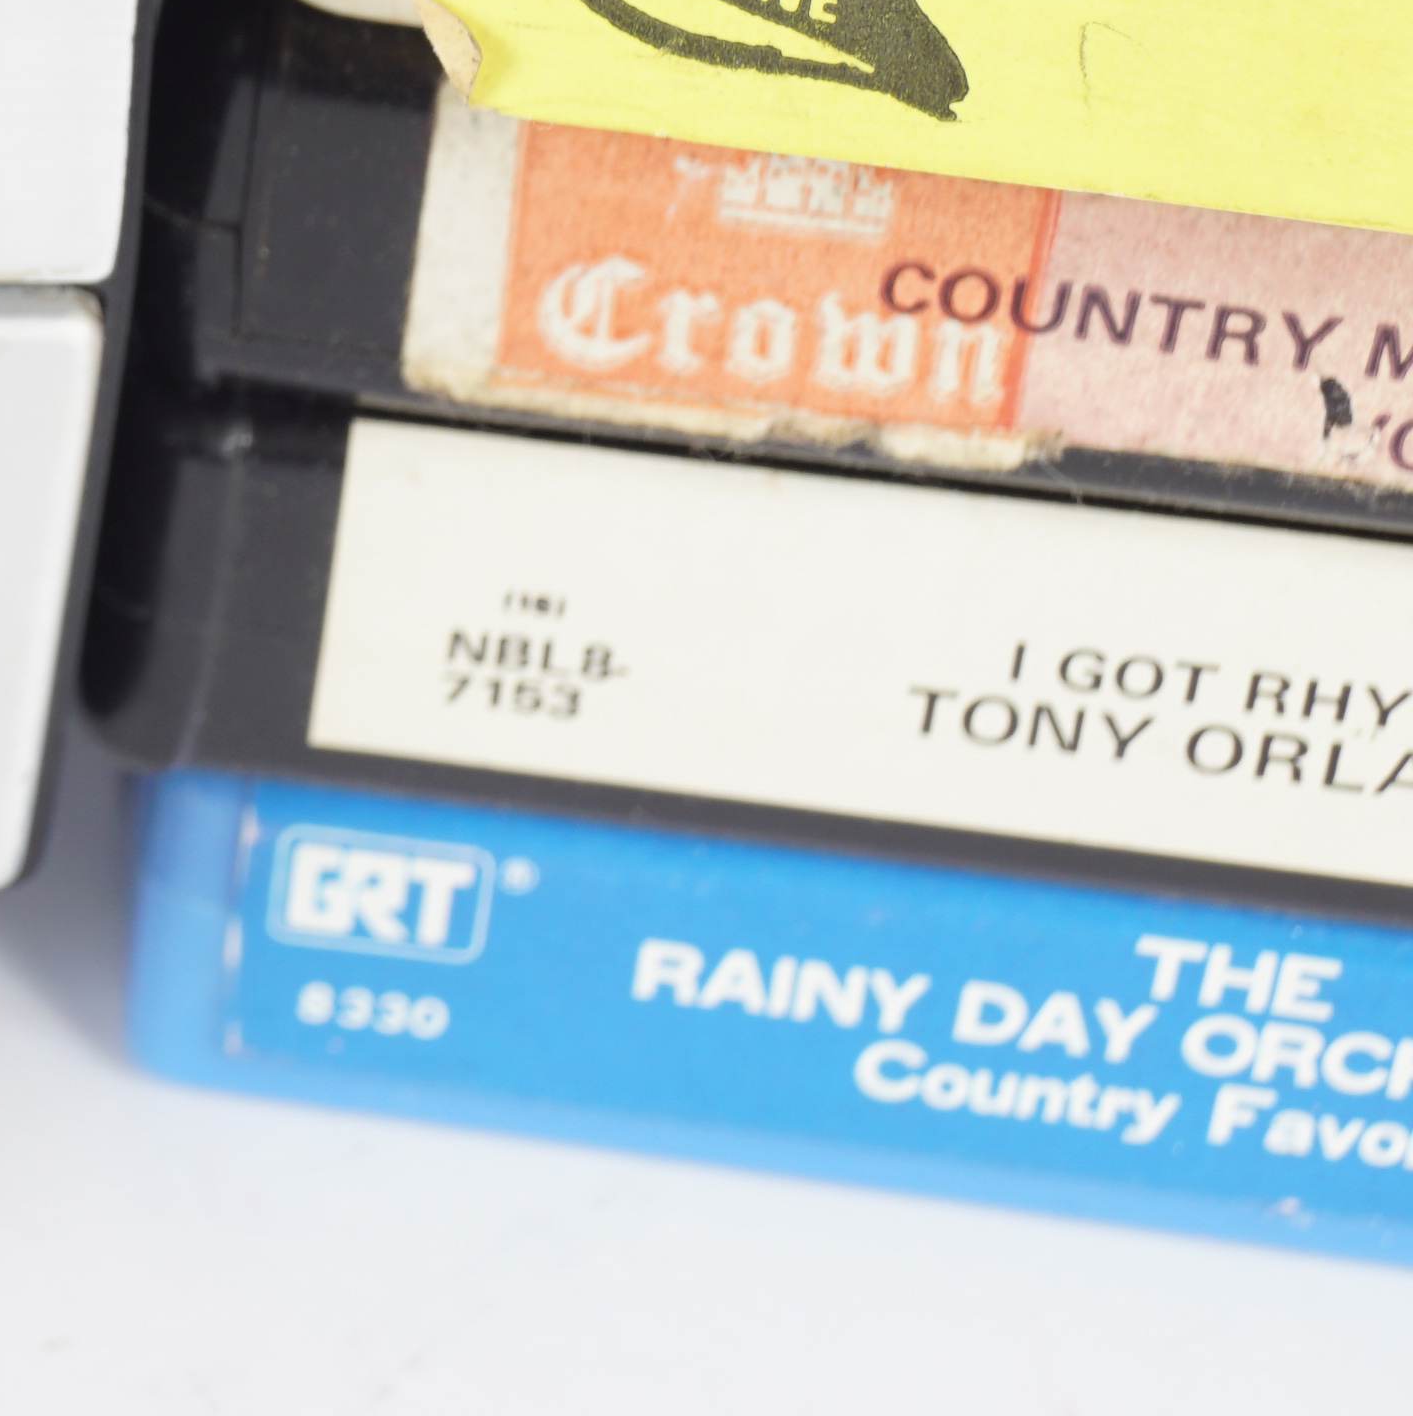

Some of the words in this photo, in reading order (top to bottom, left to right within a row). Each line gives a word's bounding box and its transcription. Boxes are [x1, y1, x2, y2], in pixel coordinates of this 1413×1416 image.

[538, 252, 1009, 408] Crown
[878, 259, 1344, 372] COUNTRY
[909, 684, 1153, 762] TONY
[1006, 640, 1029, 683] I
[1056, 646, 1221, 707] GOT
[1243, 669, 1413, 729] RHY
[285, 841, 477, 950] GRT
[630, 936, 932, 1034] RAINY
[952, 978, 1160, 1064] DAY
[1134, 932, 1345, 1024] THE
[853, 1038, 1182, 1147] Country
[1205, 1081, 1413, 1174] Favo
